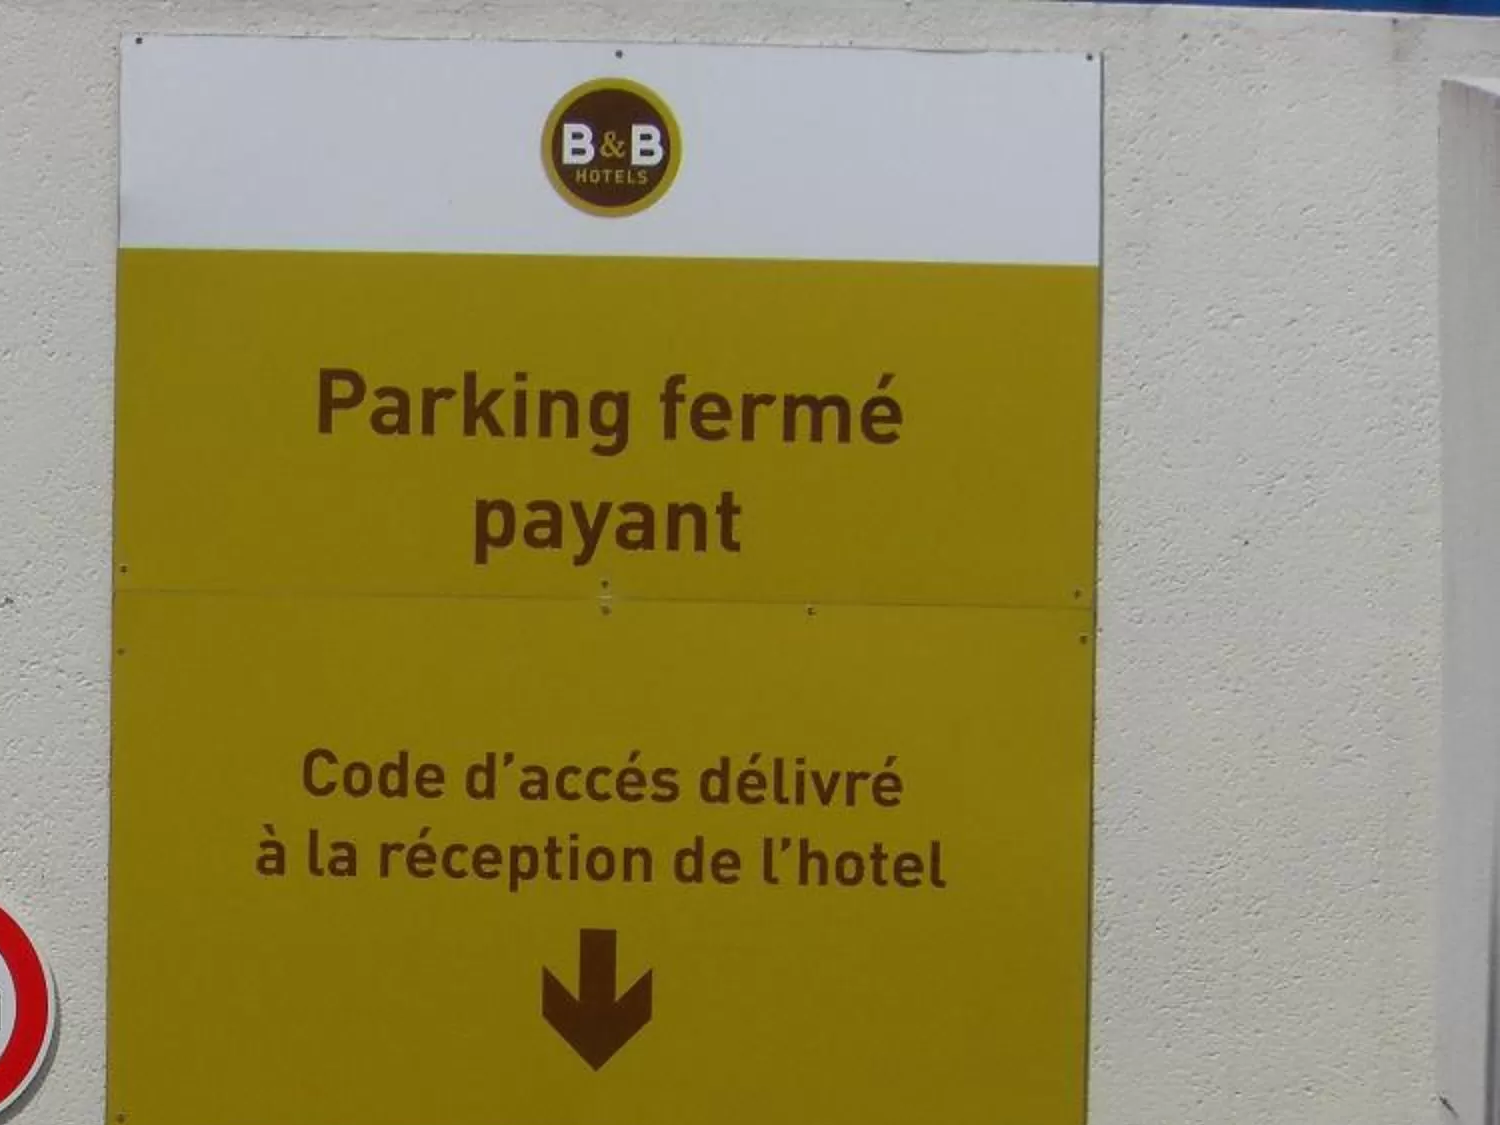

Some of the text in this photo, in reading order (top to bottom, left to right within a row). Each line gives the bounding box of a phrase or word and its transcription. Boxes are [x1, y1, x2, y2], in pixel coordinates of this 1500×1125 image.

[575, 168, 649, 185] HOTELS
[318, 367, 904, 457] Parking fermé
[475, 491, 742, 567] payant
[302, 747, 904, 808] Code d'accés délivré
[256, 823, 947, 893] à la réception de l'hotel
